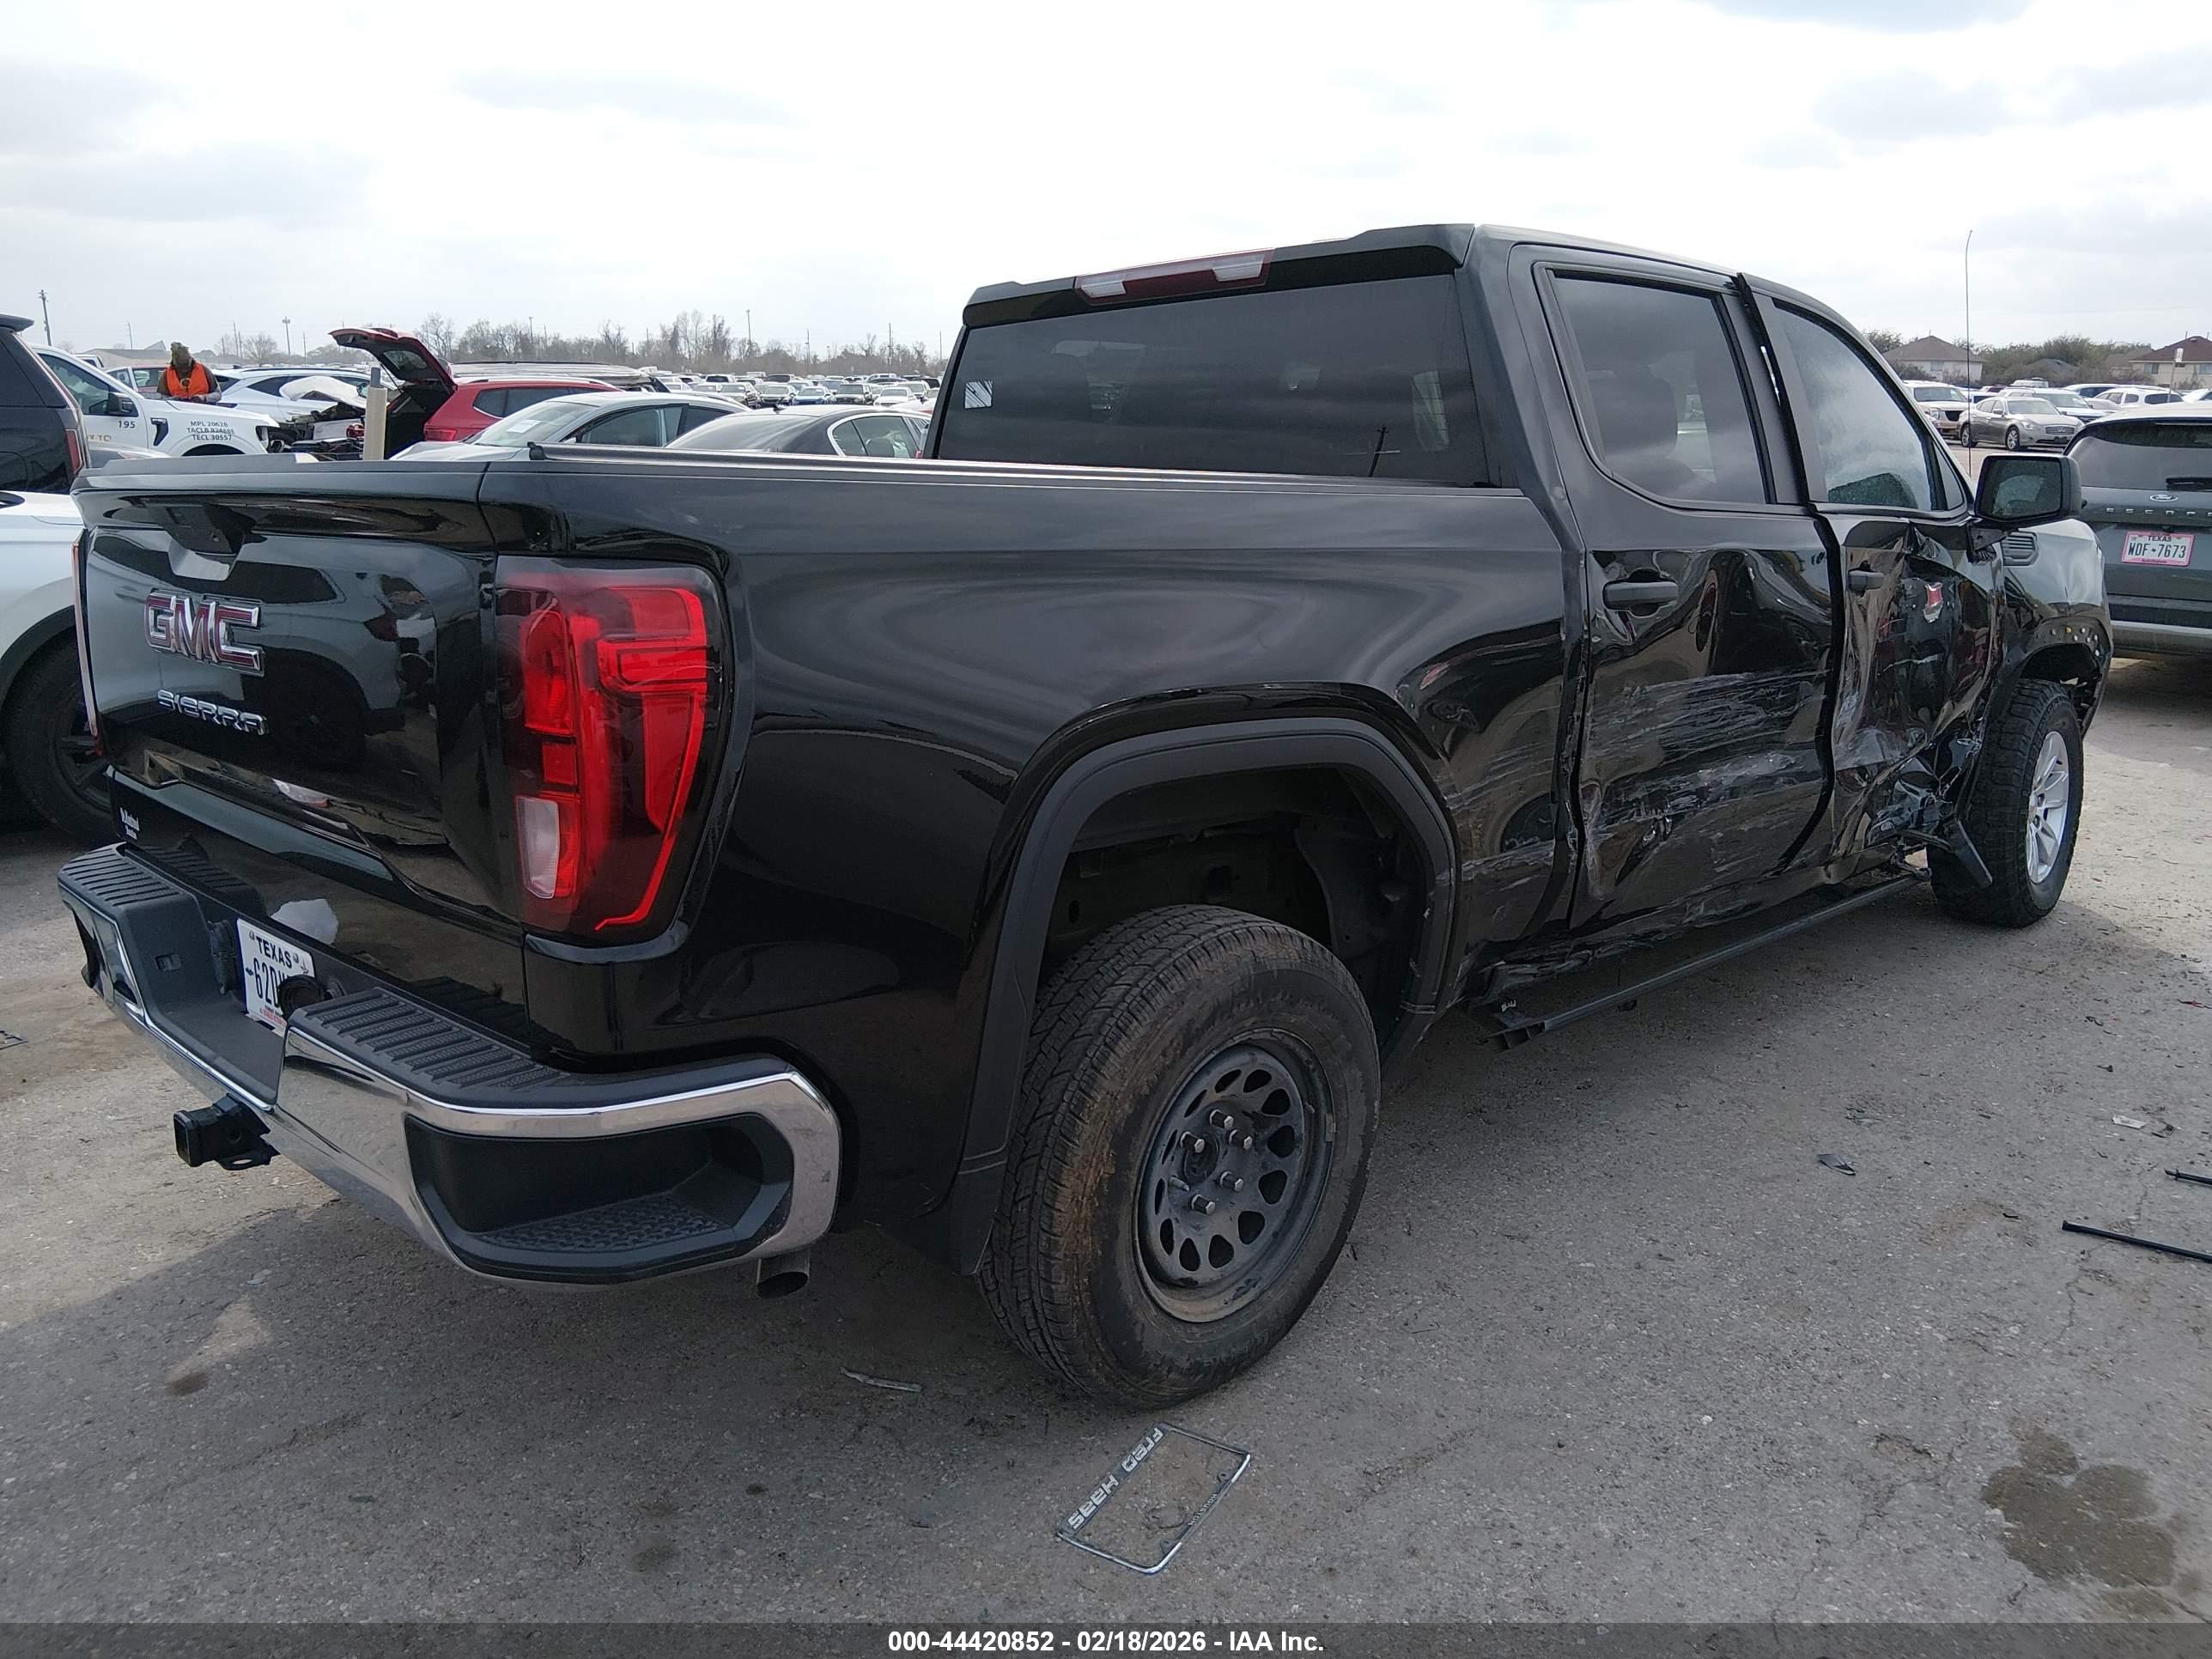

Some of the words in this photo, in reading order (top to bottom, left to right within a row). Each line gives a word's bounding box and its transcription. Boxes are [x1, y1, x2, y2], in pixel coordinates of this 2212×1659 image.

[118, 420, 136, 428] 195
[2157, 544, 2186, 558] 7673
[144, 589, 264, 676] GMC
[157, 689, 267, 736] SIERRA
[256, 936, 293, 969] TEXAS
